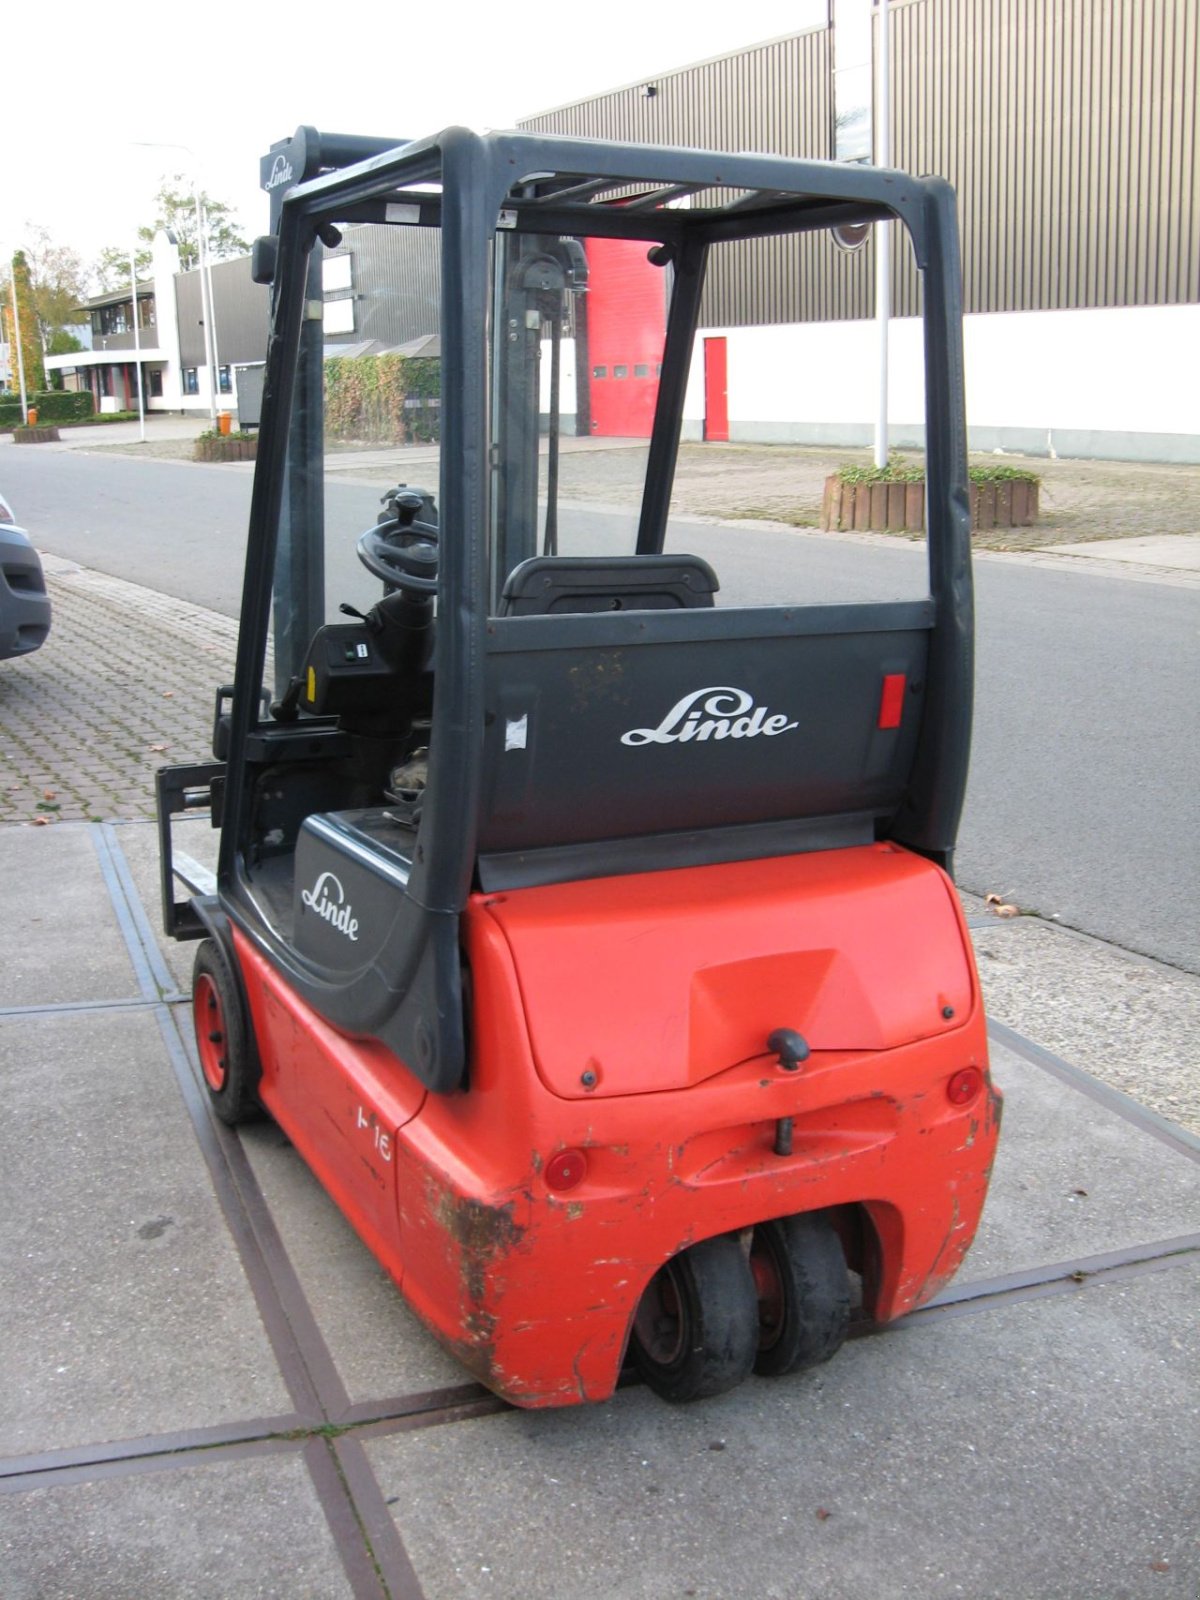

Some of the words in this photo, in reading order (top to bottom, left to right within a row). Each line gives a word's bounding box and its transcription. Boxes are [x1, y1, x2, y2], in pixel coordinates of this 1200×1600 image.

[265, 155, 293, 190] Linde
[620, 686, 799, 746] Linde
[302, 872, 358, 941] Linde
